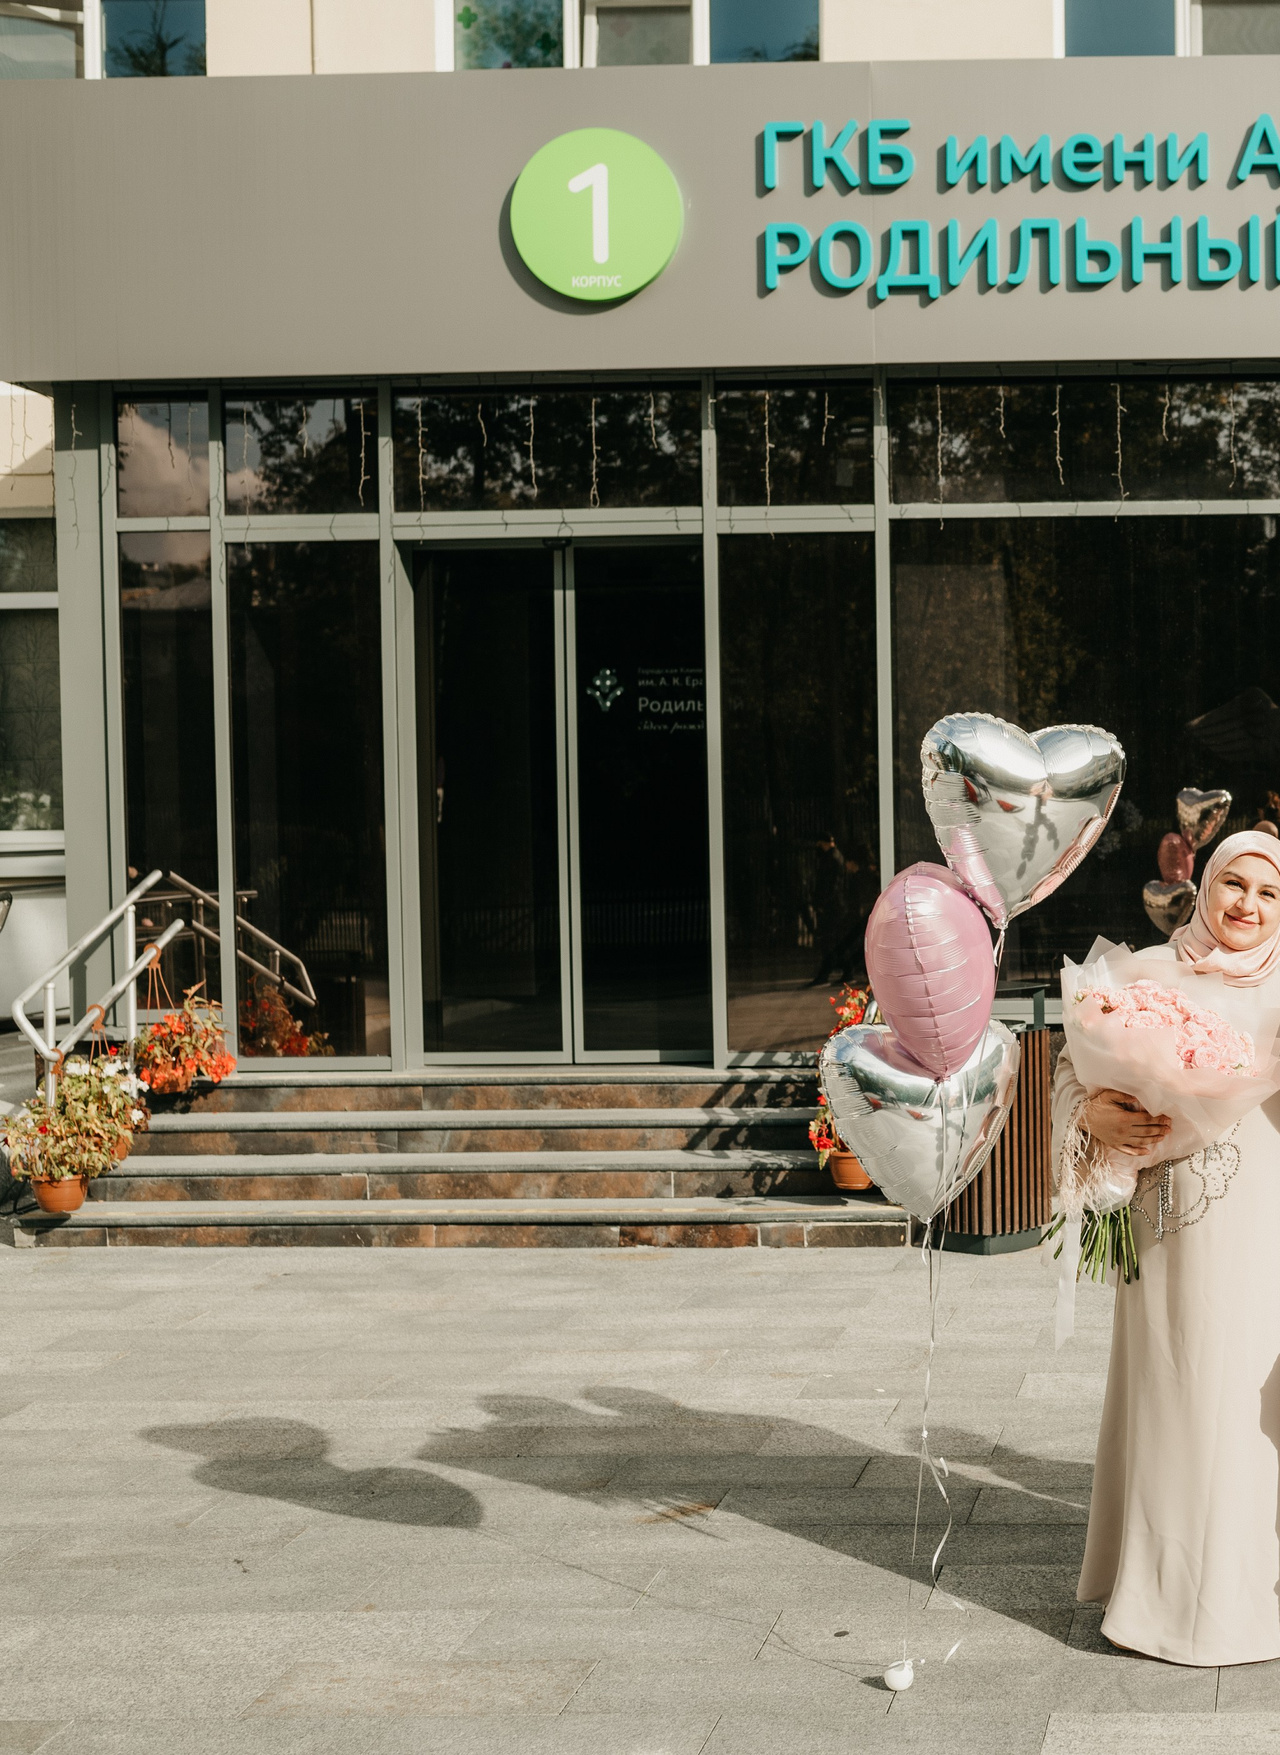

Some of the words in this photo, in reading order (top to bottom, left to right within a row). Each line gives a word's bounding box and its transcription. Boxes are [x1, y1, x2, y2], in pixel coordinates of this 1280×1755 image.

[762, 118, 915, 189] ГКБ
[944, 131, 1210, 186] имени
[567, 162, 610, 265] 1
[571, 274, 622, 288] КОРПУС
